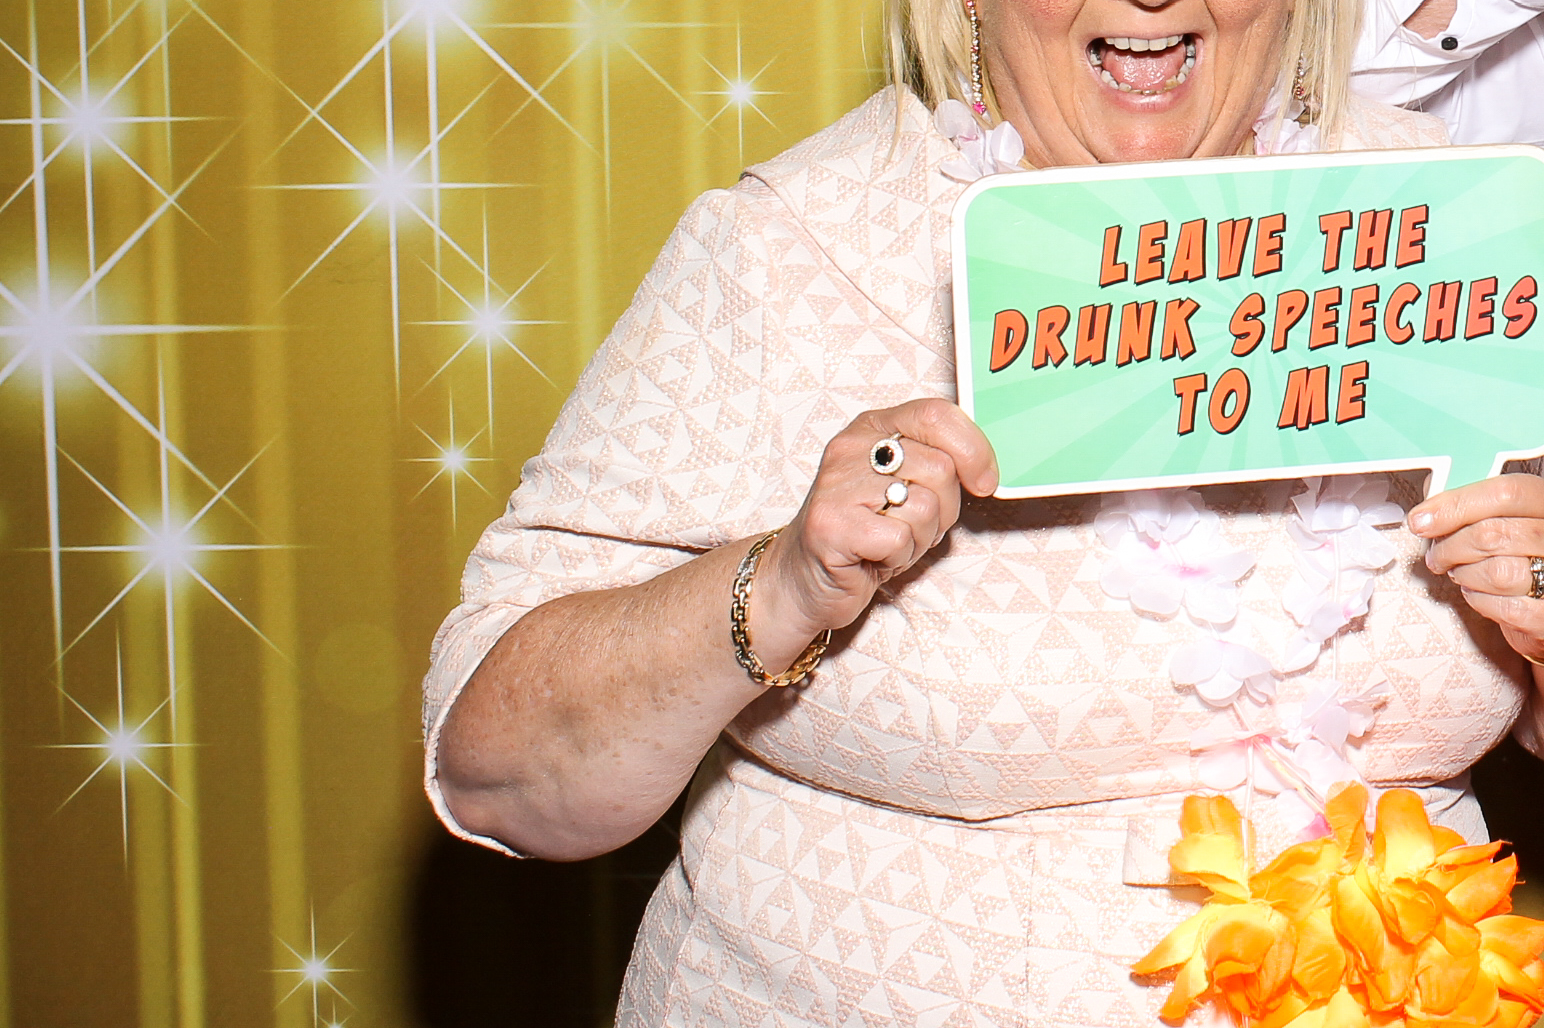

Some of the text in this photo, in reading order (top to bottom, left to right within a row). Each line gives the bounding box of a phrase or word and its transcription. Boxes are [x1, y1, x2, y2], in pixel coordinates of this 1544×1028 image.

[1099, 204, 1429, 288] LEAVE THE
[989, 275, 1538, 374] DRUNK SPEECHES
[1173, 361, 1369, 436] TO ME
